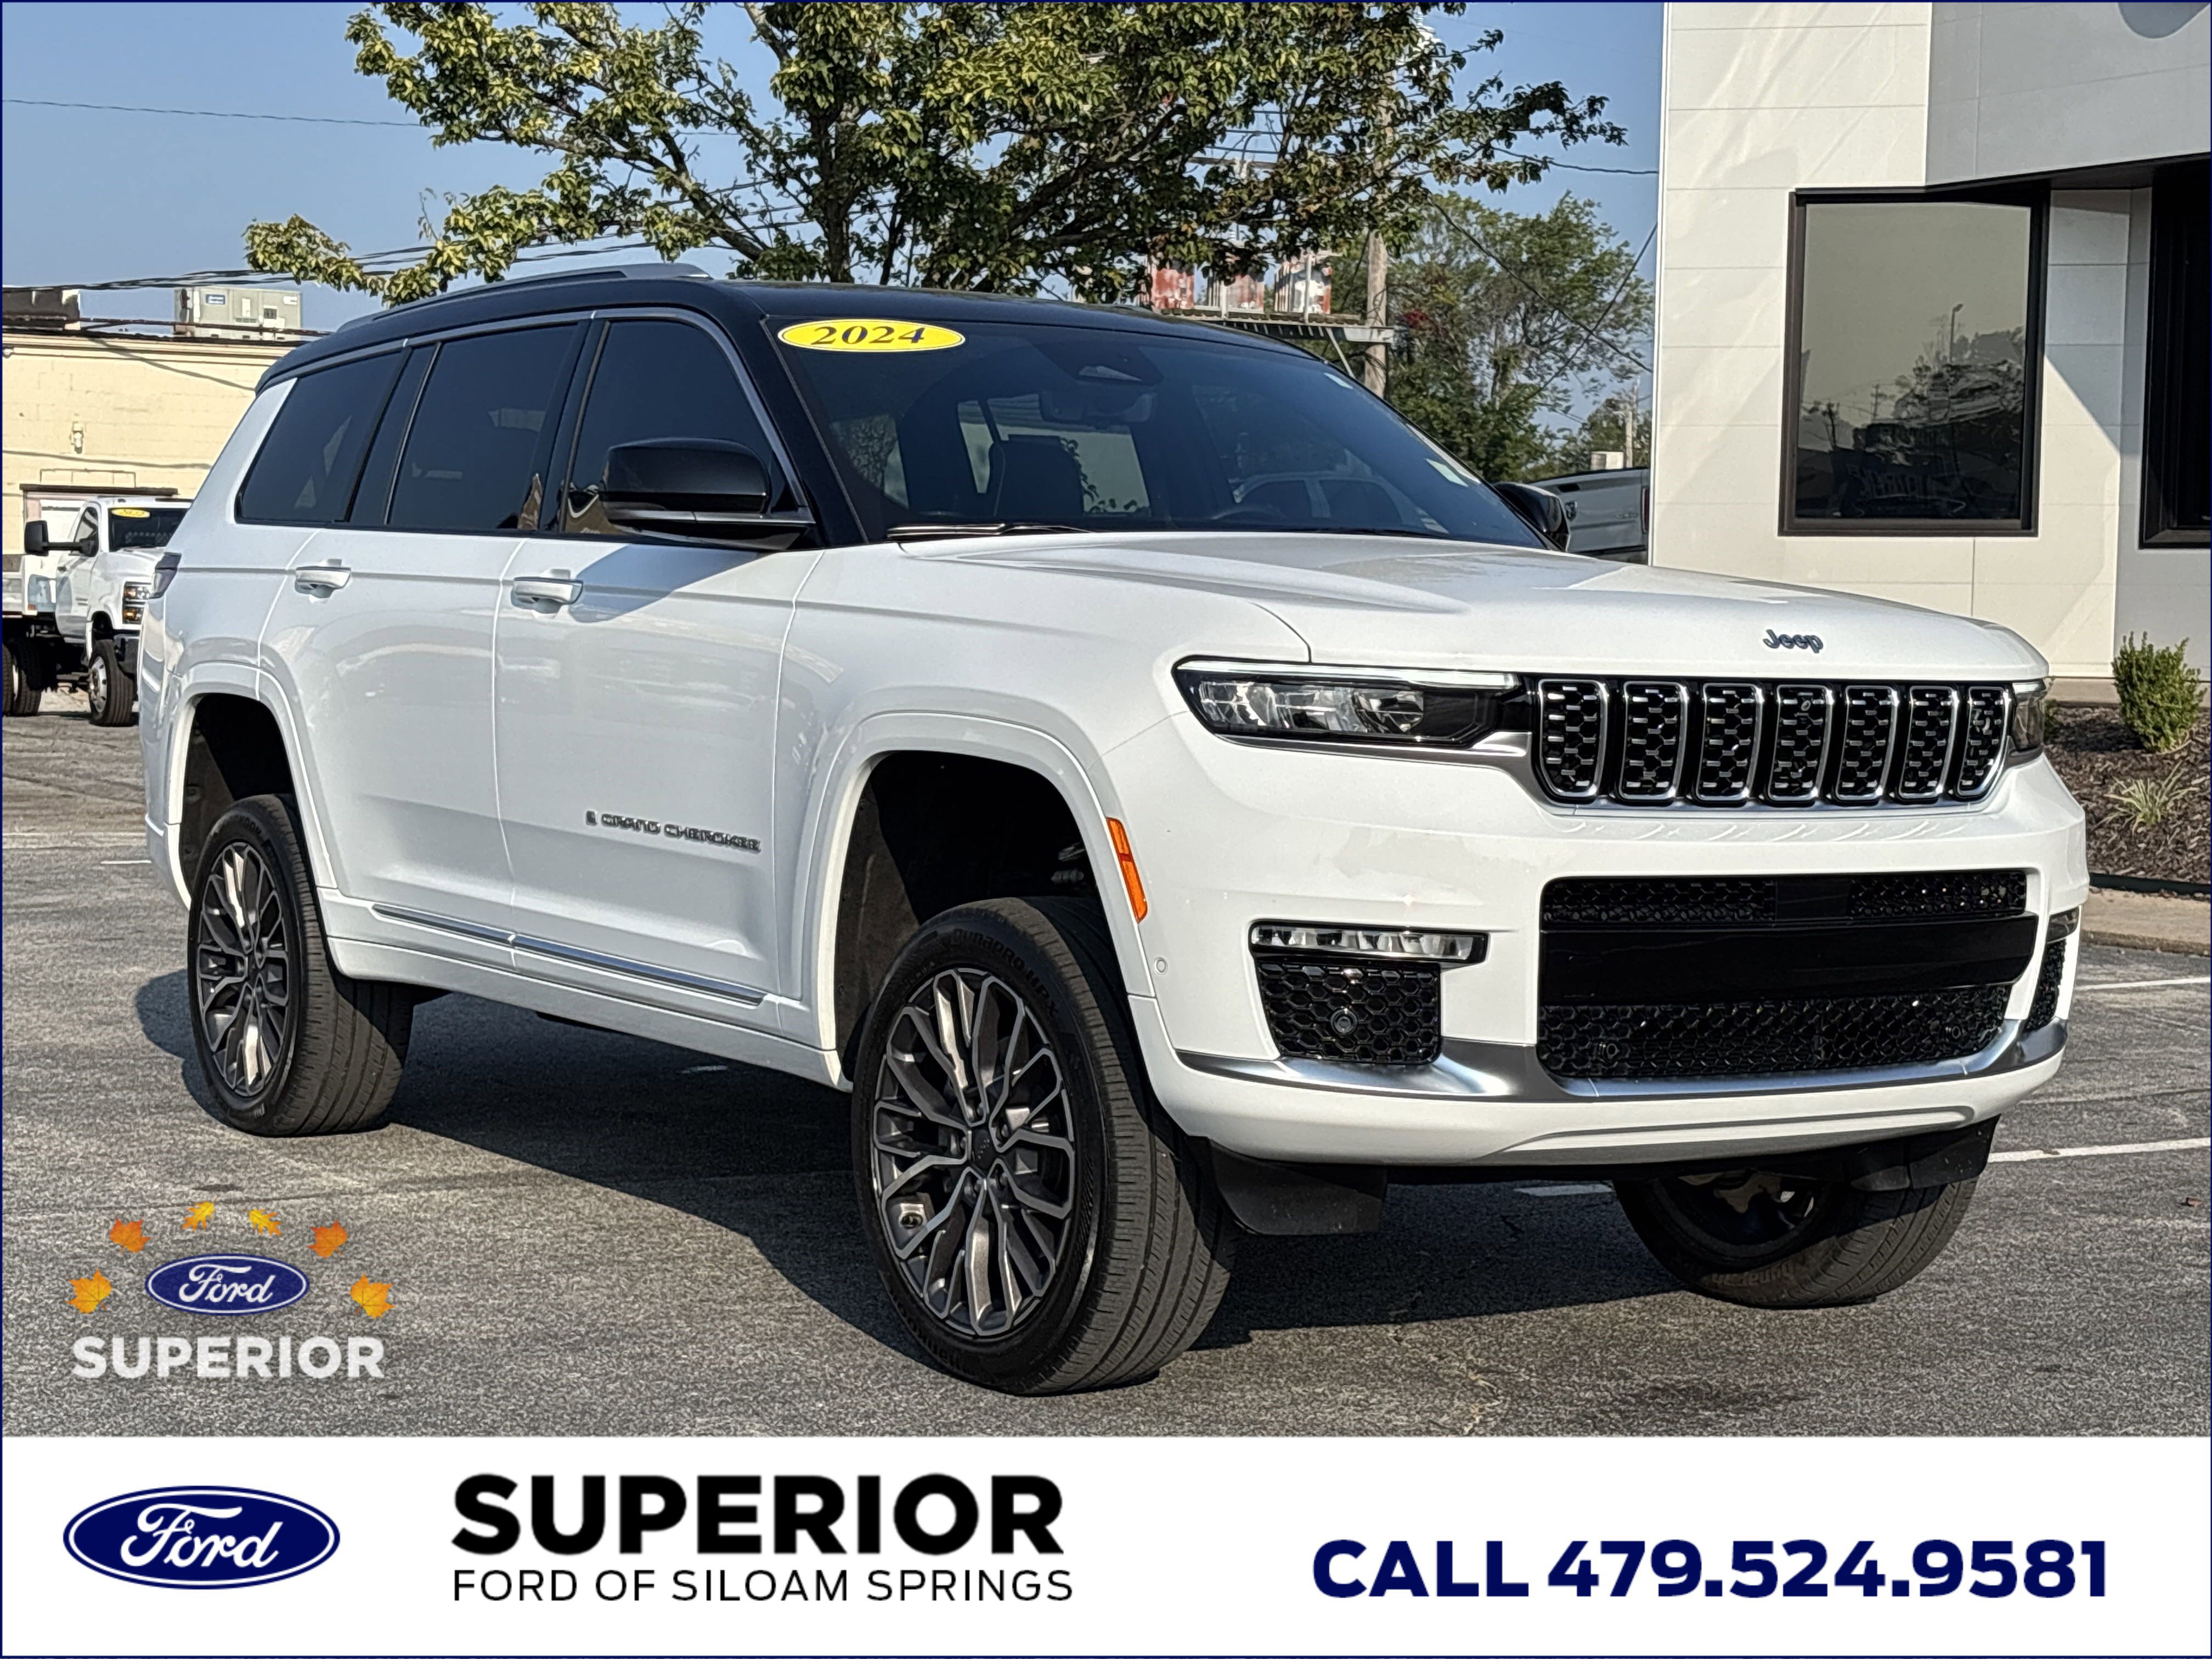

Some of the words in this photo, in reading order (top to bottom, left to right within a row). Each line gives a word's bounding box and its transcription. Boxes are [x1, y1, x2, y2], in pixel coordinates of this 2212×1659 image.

[810, 325, 926, 346] 2024
[1763, 629, 1824, 654] Jeep
[601, 813, 661, 835] GRAND
[664, 823, 761, 853] CHEROKEE
